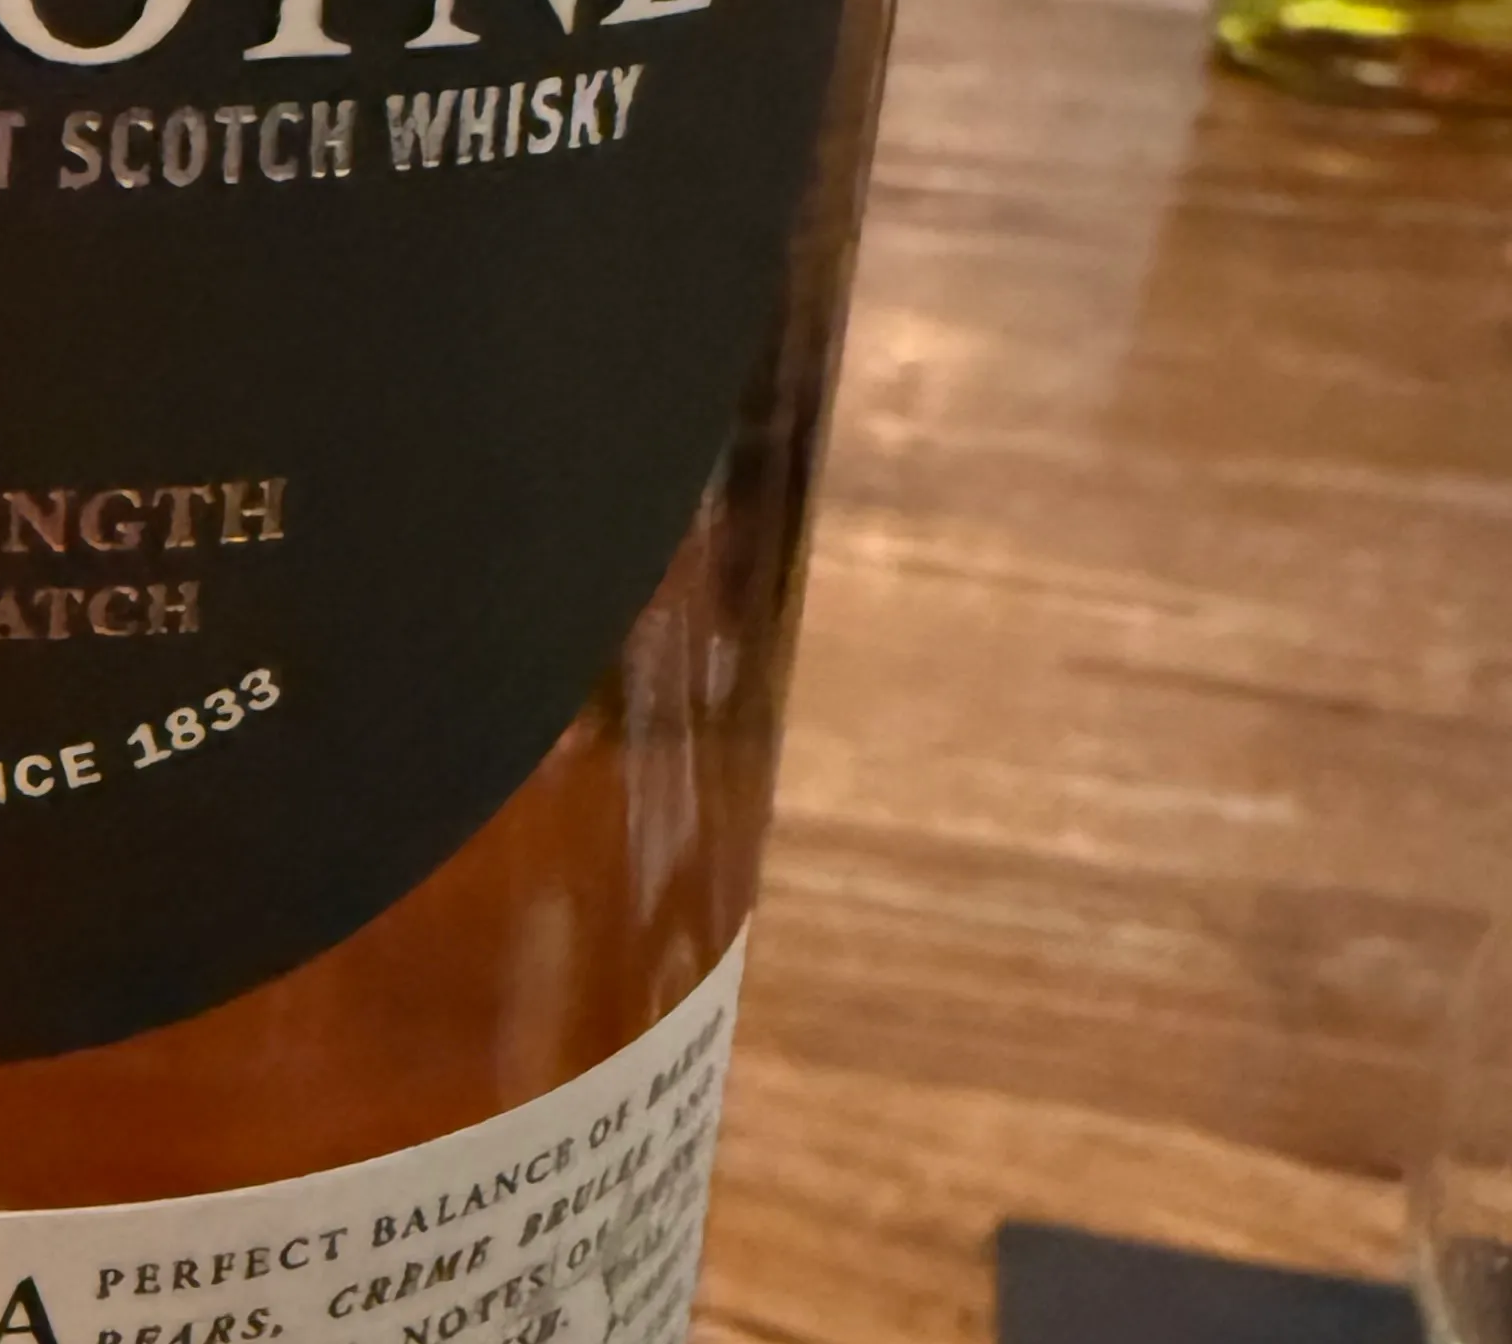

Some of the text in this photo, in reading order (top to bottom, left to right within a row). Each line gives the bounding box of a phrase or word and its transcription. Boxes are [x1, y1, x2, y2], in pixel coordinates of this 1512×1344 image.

[59, 100, 356, 191] SCOTCH
[386, 64, 645, 171] WHISKY
[126, 666, 282, 770] 1833
[96, 1226, 349, 1301] PERFECT
[371, 1136, 576, 1249] BALANCE
[589, 1099, 630, 1151] OF
[566, 1216, 612, 1271] OF
